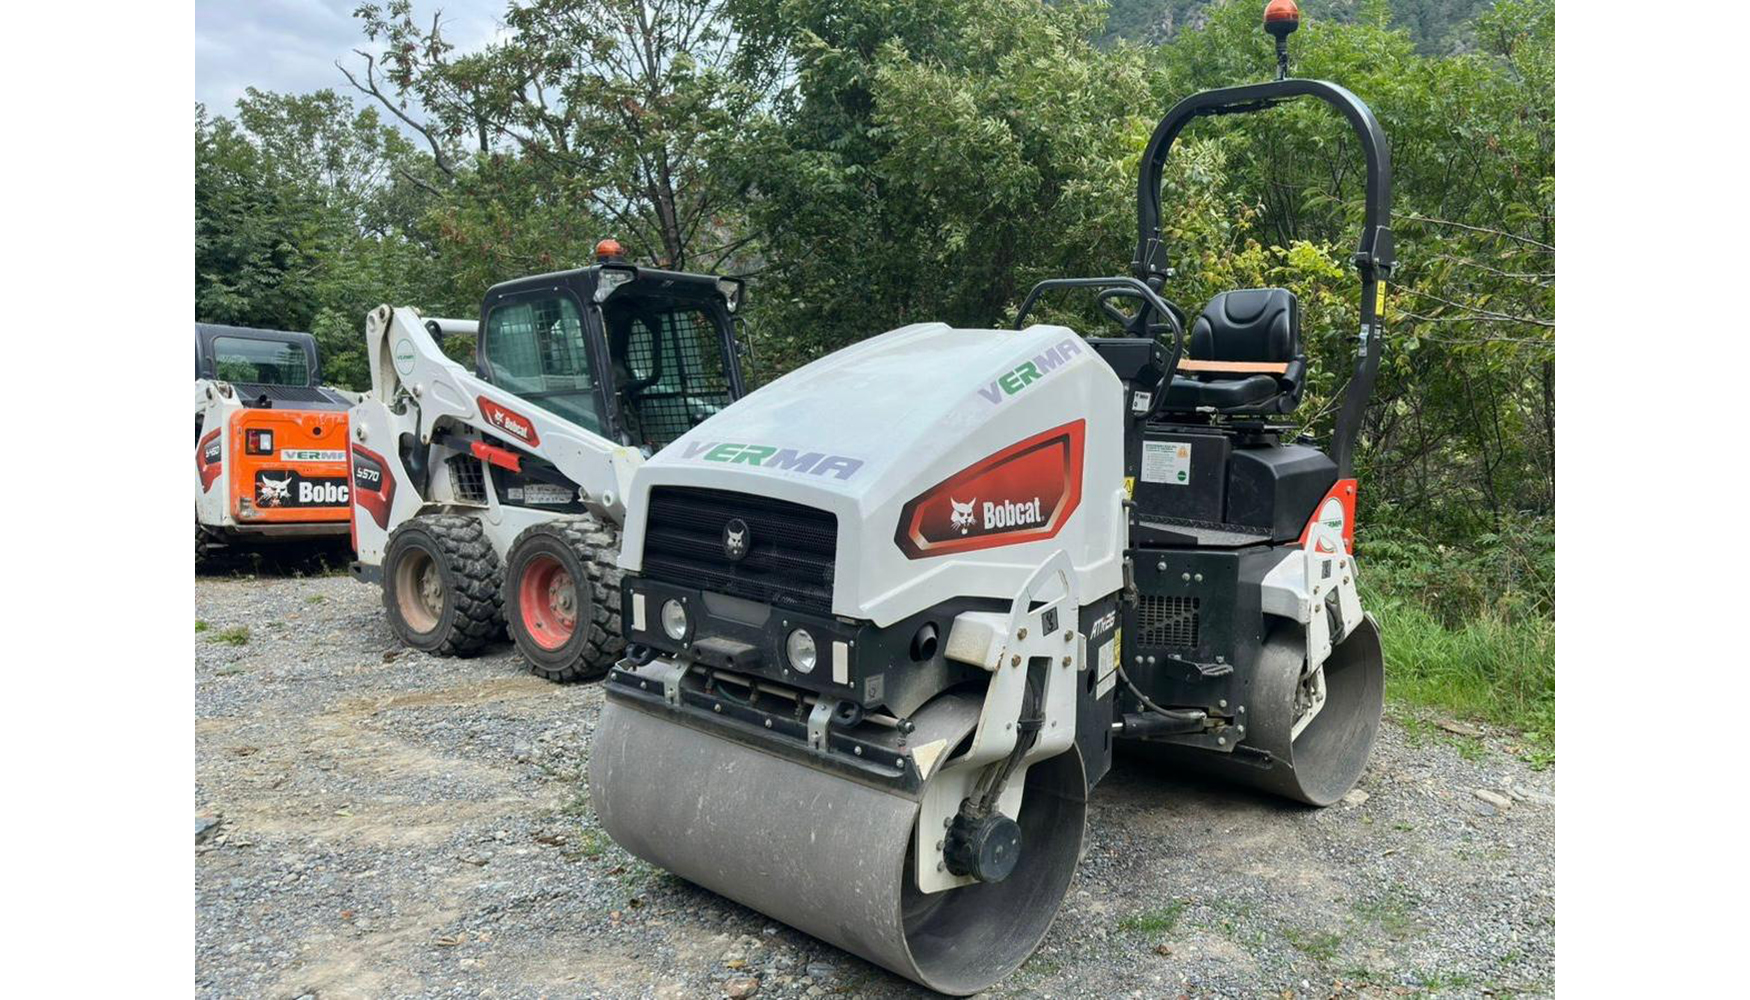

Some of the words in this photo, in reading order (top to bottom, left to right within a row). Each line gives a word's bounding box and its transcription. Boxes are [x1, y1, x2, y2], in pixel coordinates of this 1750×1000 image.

[977, 338, 1082, 404] VERMA
[505, 416, 528, 438] Bobcat
[356, 467, 380, 482] S570
[681, 441, 864, 480] VERMA
[983, 497, 1042, 530] Bobcat
